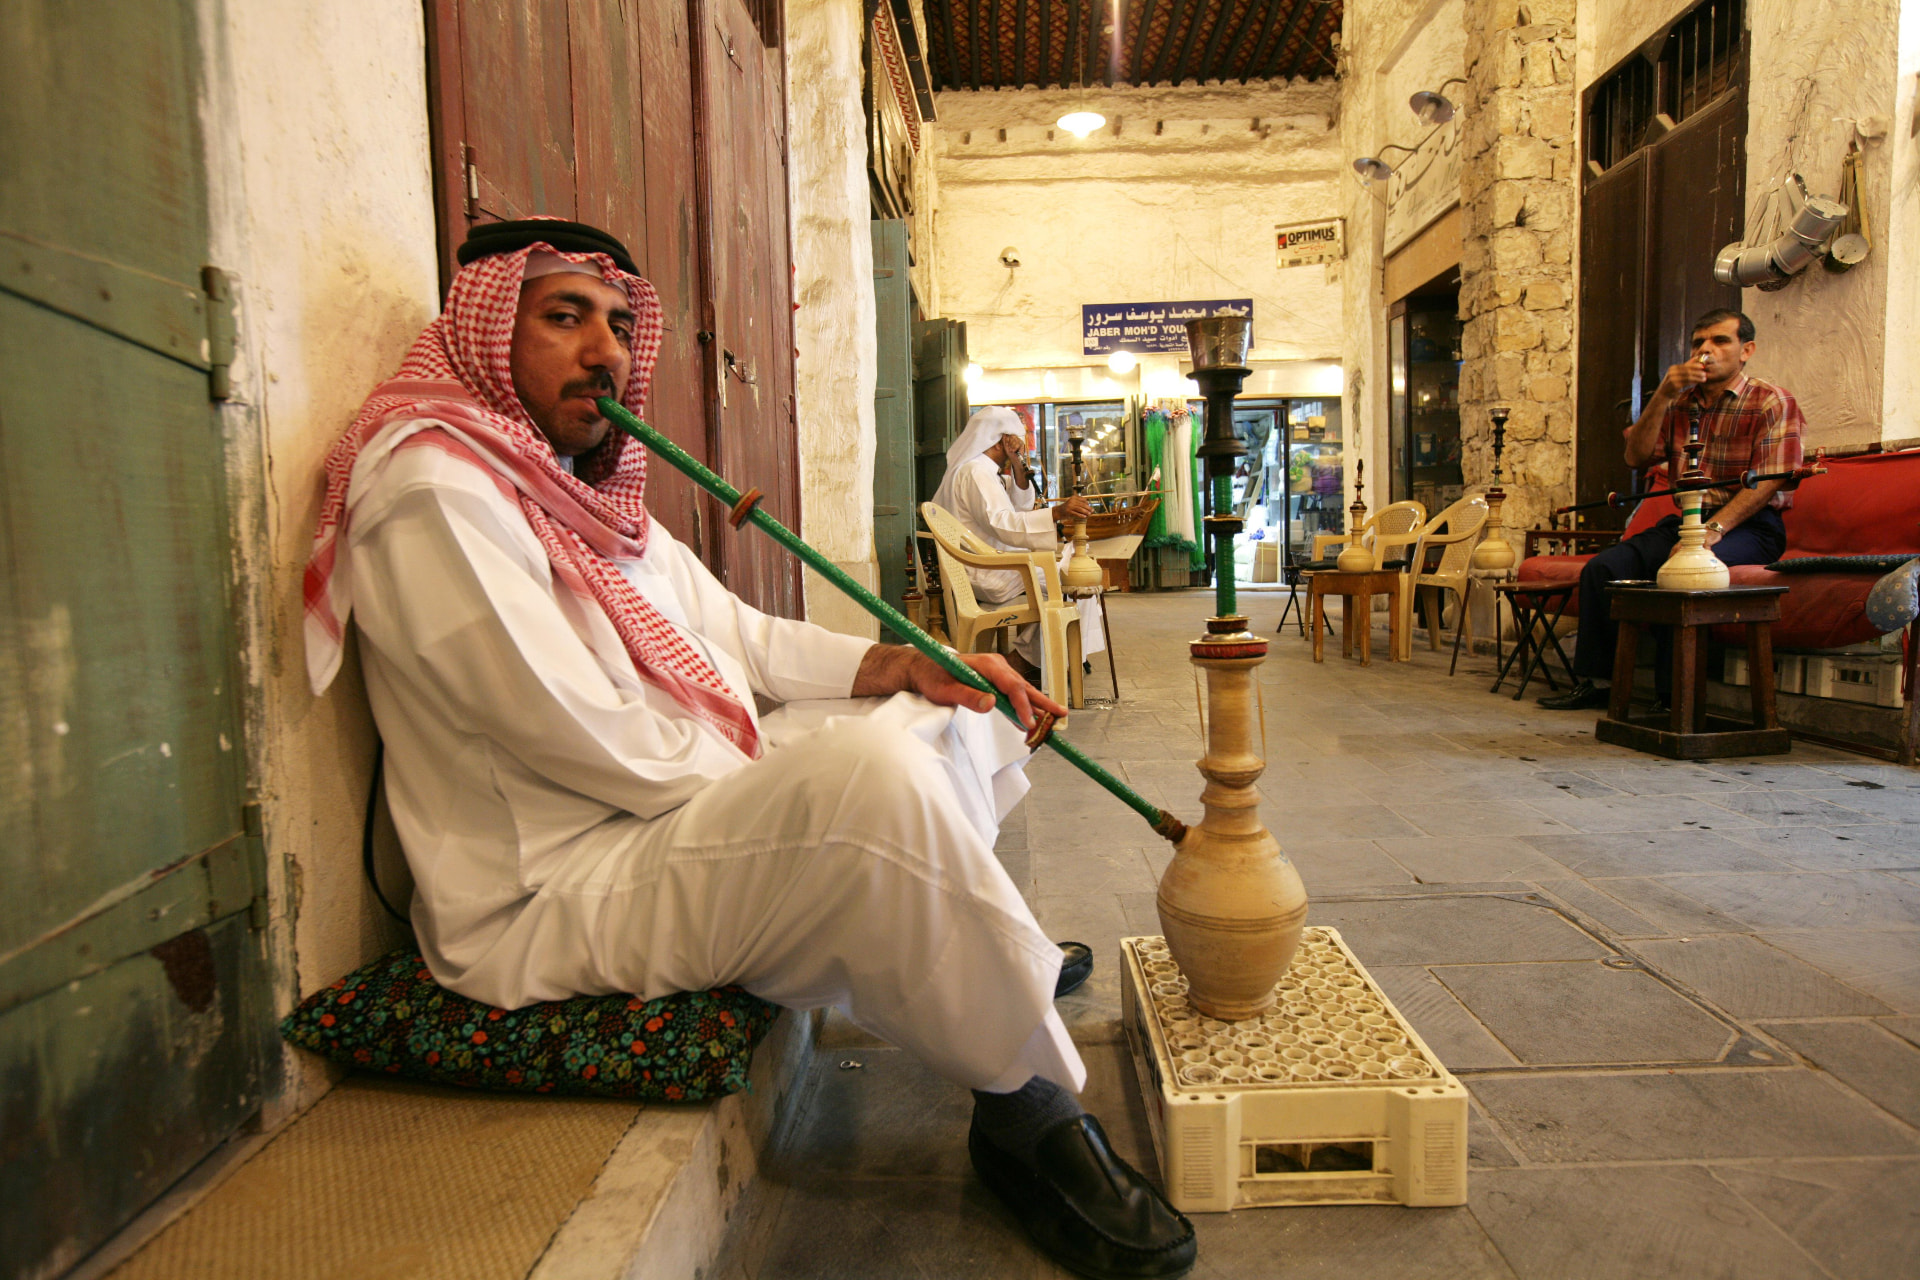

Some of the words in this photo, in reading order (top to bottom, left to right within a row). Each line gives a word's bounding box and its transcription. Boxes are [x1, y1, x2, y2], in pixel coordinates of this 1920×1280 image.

[1288, 227, 1334, 244] OPTIMUS
[1087, 311, 1123, 326] سرور
[1126, 307, 1165, 324] يوسف
[1168, 306, 1206, 319] محمد
[1087, 327, 1121, 337] JABER
[1124, 325, 1158, 336] MOH'D
